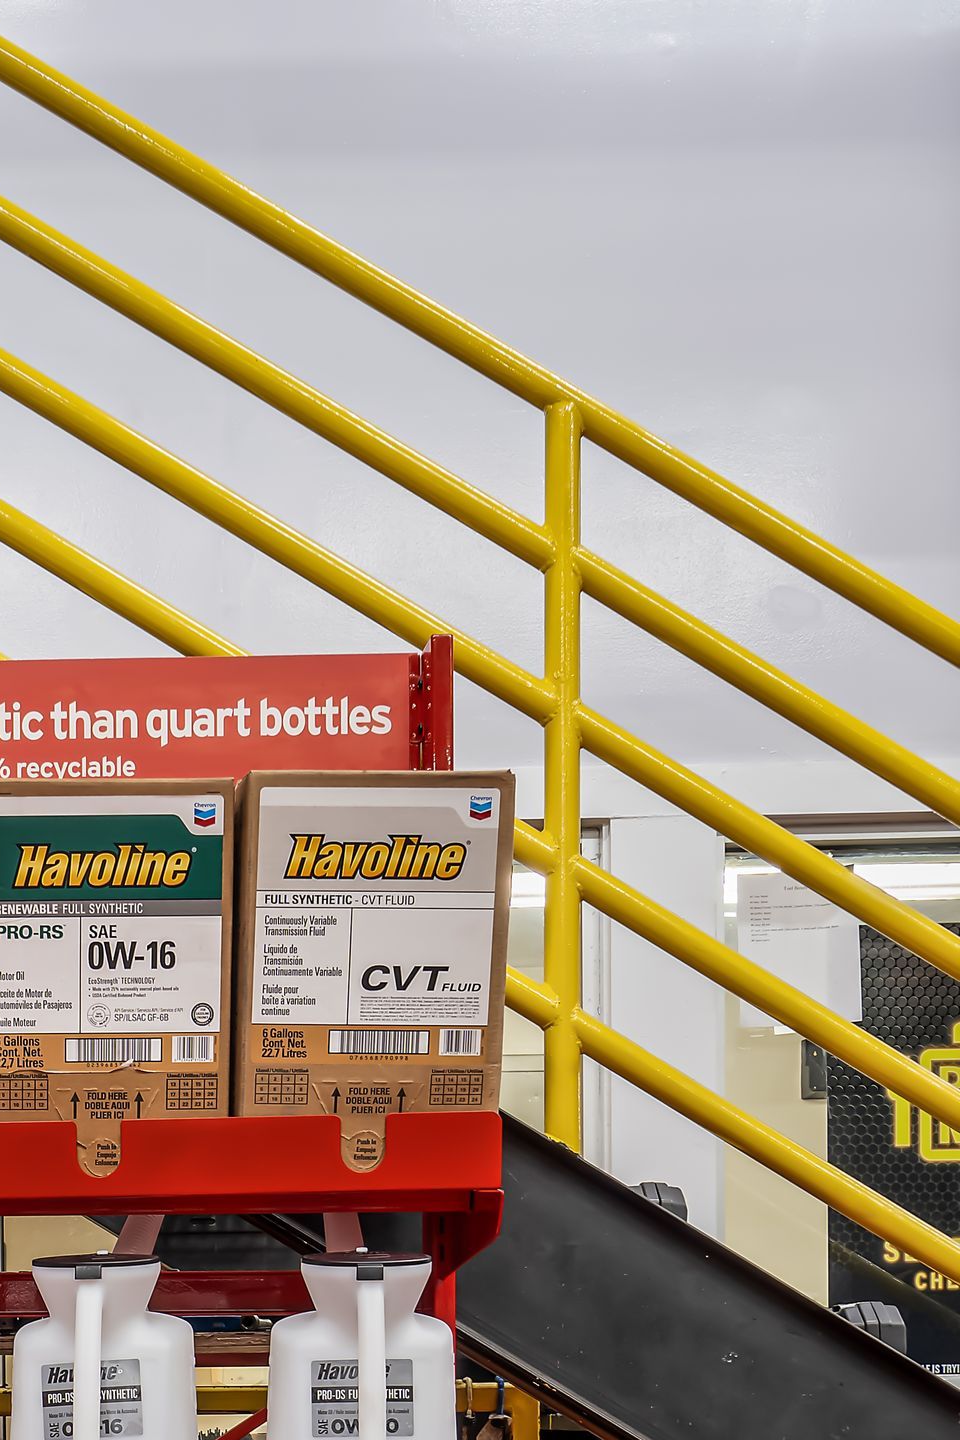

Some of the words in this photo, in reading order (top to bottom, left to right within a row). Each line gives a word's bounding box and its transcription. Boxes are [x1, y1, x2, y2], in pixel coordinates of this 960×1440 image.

[49, 701, 138, 740] than
[146, 697, 251, 748] quart
[259, 696, 392, 737] bottles
[16, 756, 136, 779] recyclable
[283, 833, 467, 881] Havoline
[12, 842, 193, 889] Havoline
[264, 894, 289, 905] FULL
[291, 894, 353, 905] SYNTHETIC
[361, 895, 383, 905] CVT
[385, 895, 415, 905] FLUID
[62, 903, 85, 914] FULL
[88, 903, 144, 914] SYNTHETIC
[264, 915, 308, 926] Continuously
[309, 915, 337, 925] Variable
[88, 924, 117, 939] SAE
[264, 926, 308, 937] Transmission
[309, 926, 326, 937] Fluid
[88, 941, 176, 970] 0W-16
[15, 971, 25, 981] Oil
[361, 965, 450, 993] CVT
[441, 983, 482, 992] FLUID
[15, 989, 24, 998] de
[25, 989, 44, 998] Motor
[45, 989, 52, 998] de
[33, 1000, 41, 1009] de
[42, 1000, 73, 1012] Pasajeros
[13, 1018, 36, 1027] Moteur
[317, 1389, 346, 1400] PRO-DS
[50, 1422, 60, 1438] SAE
[318, 1419, 329, 1435] SAE
